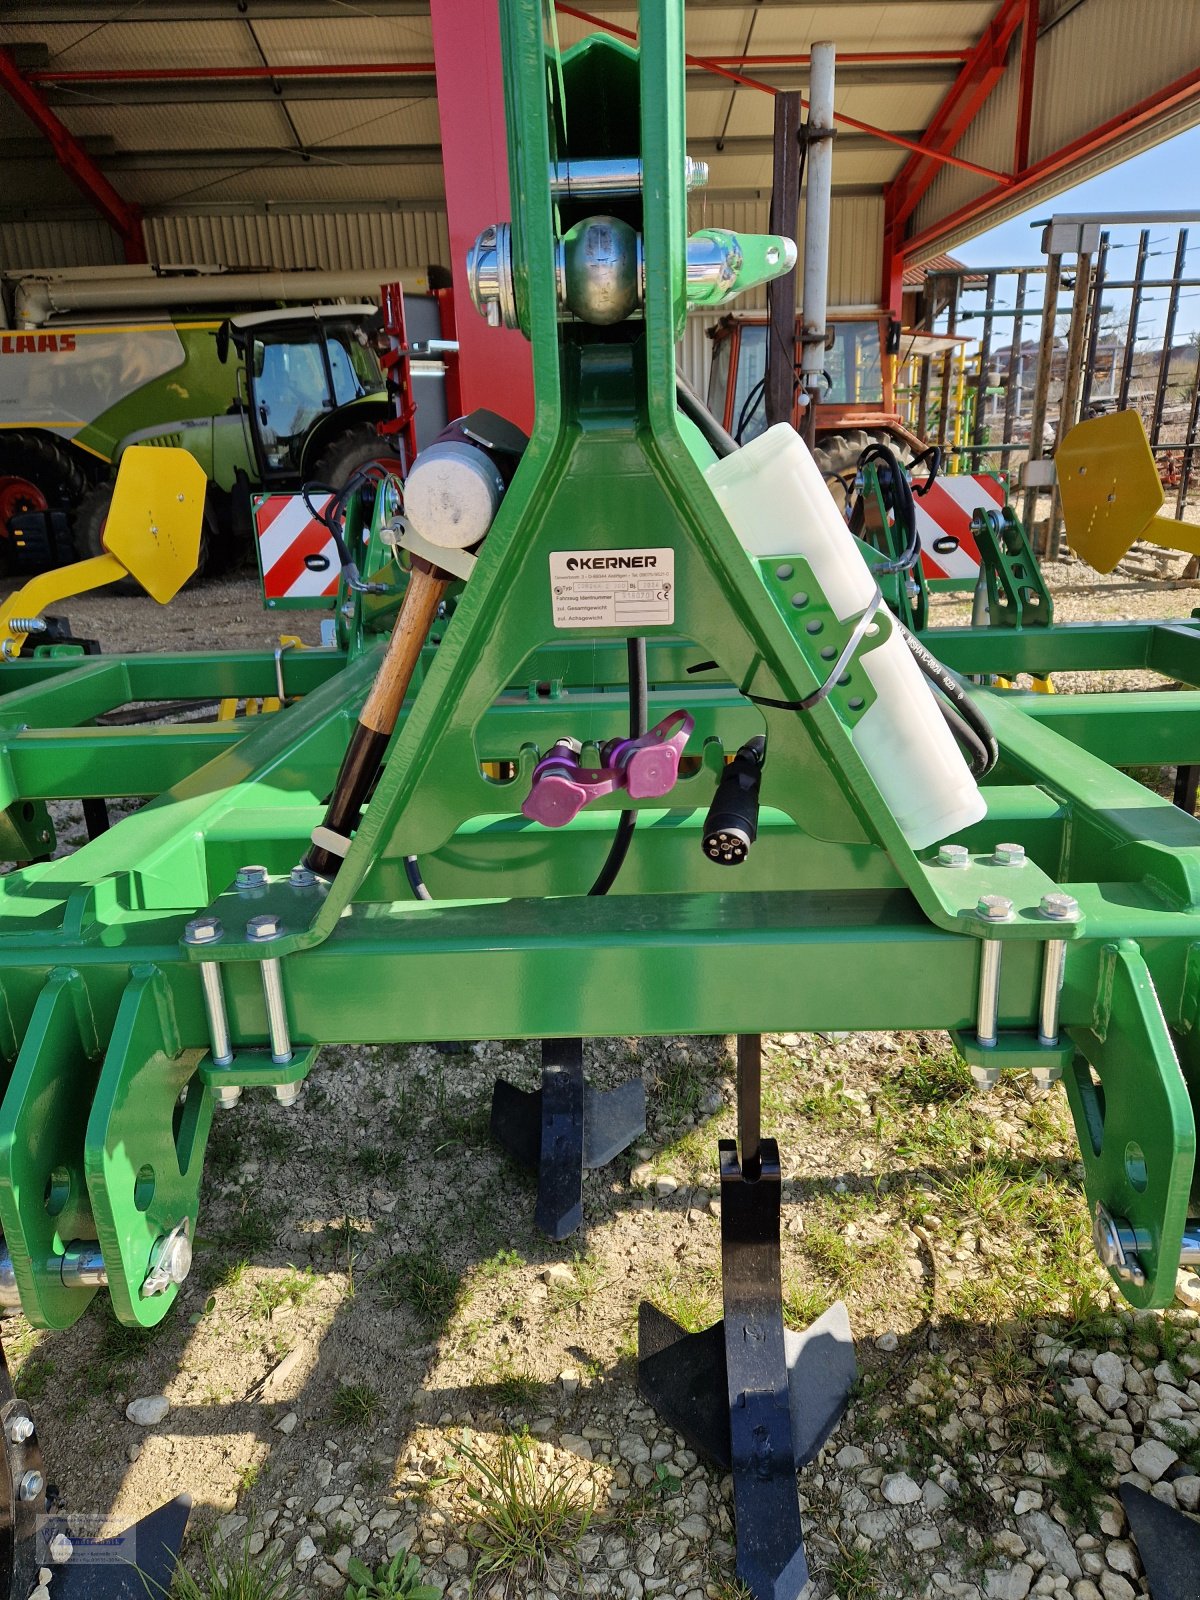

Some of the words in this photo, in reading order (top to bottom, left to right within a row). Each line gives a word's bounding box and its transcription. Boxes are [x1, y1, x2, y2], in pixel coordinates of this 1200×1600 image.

[0, 334, 76, 353] LAAS
[580, 556, 657, 570] KERNER
[907, 637, 922, 657] MSHA
